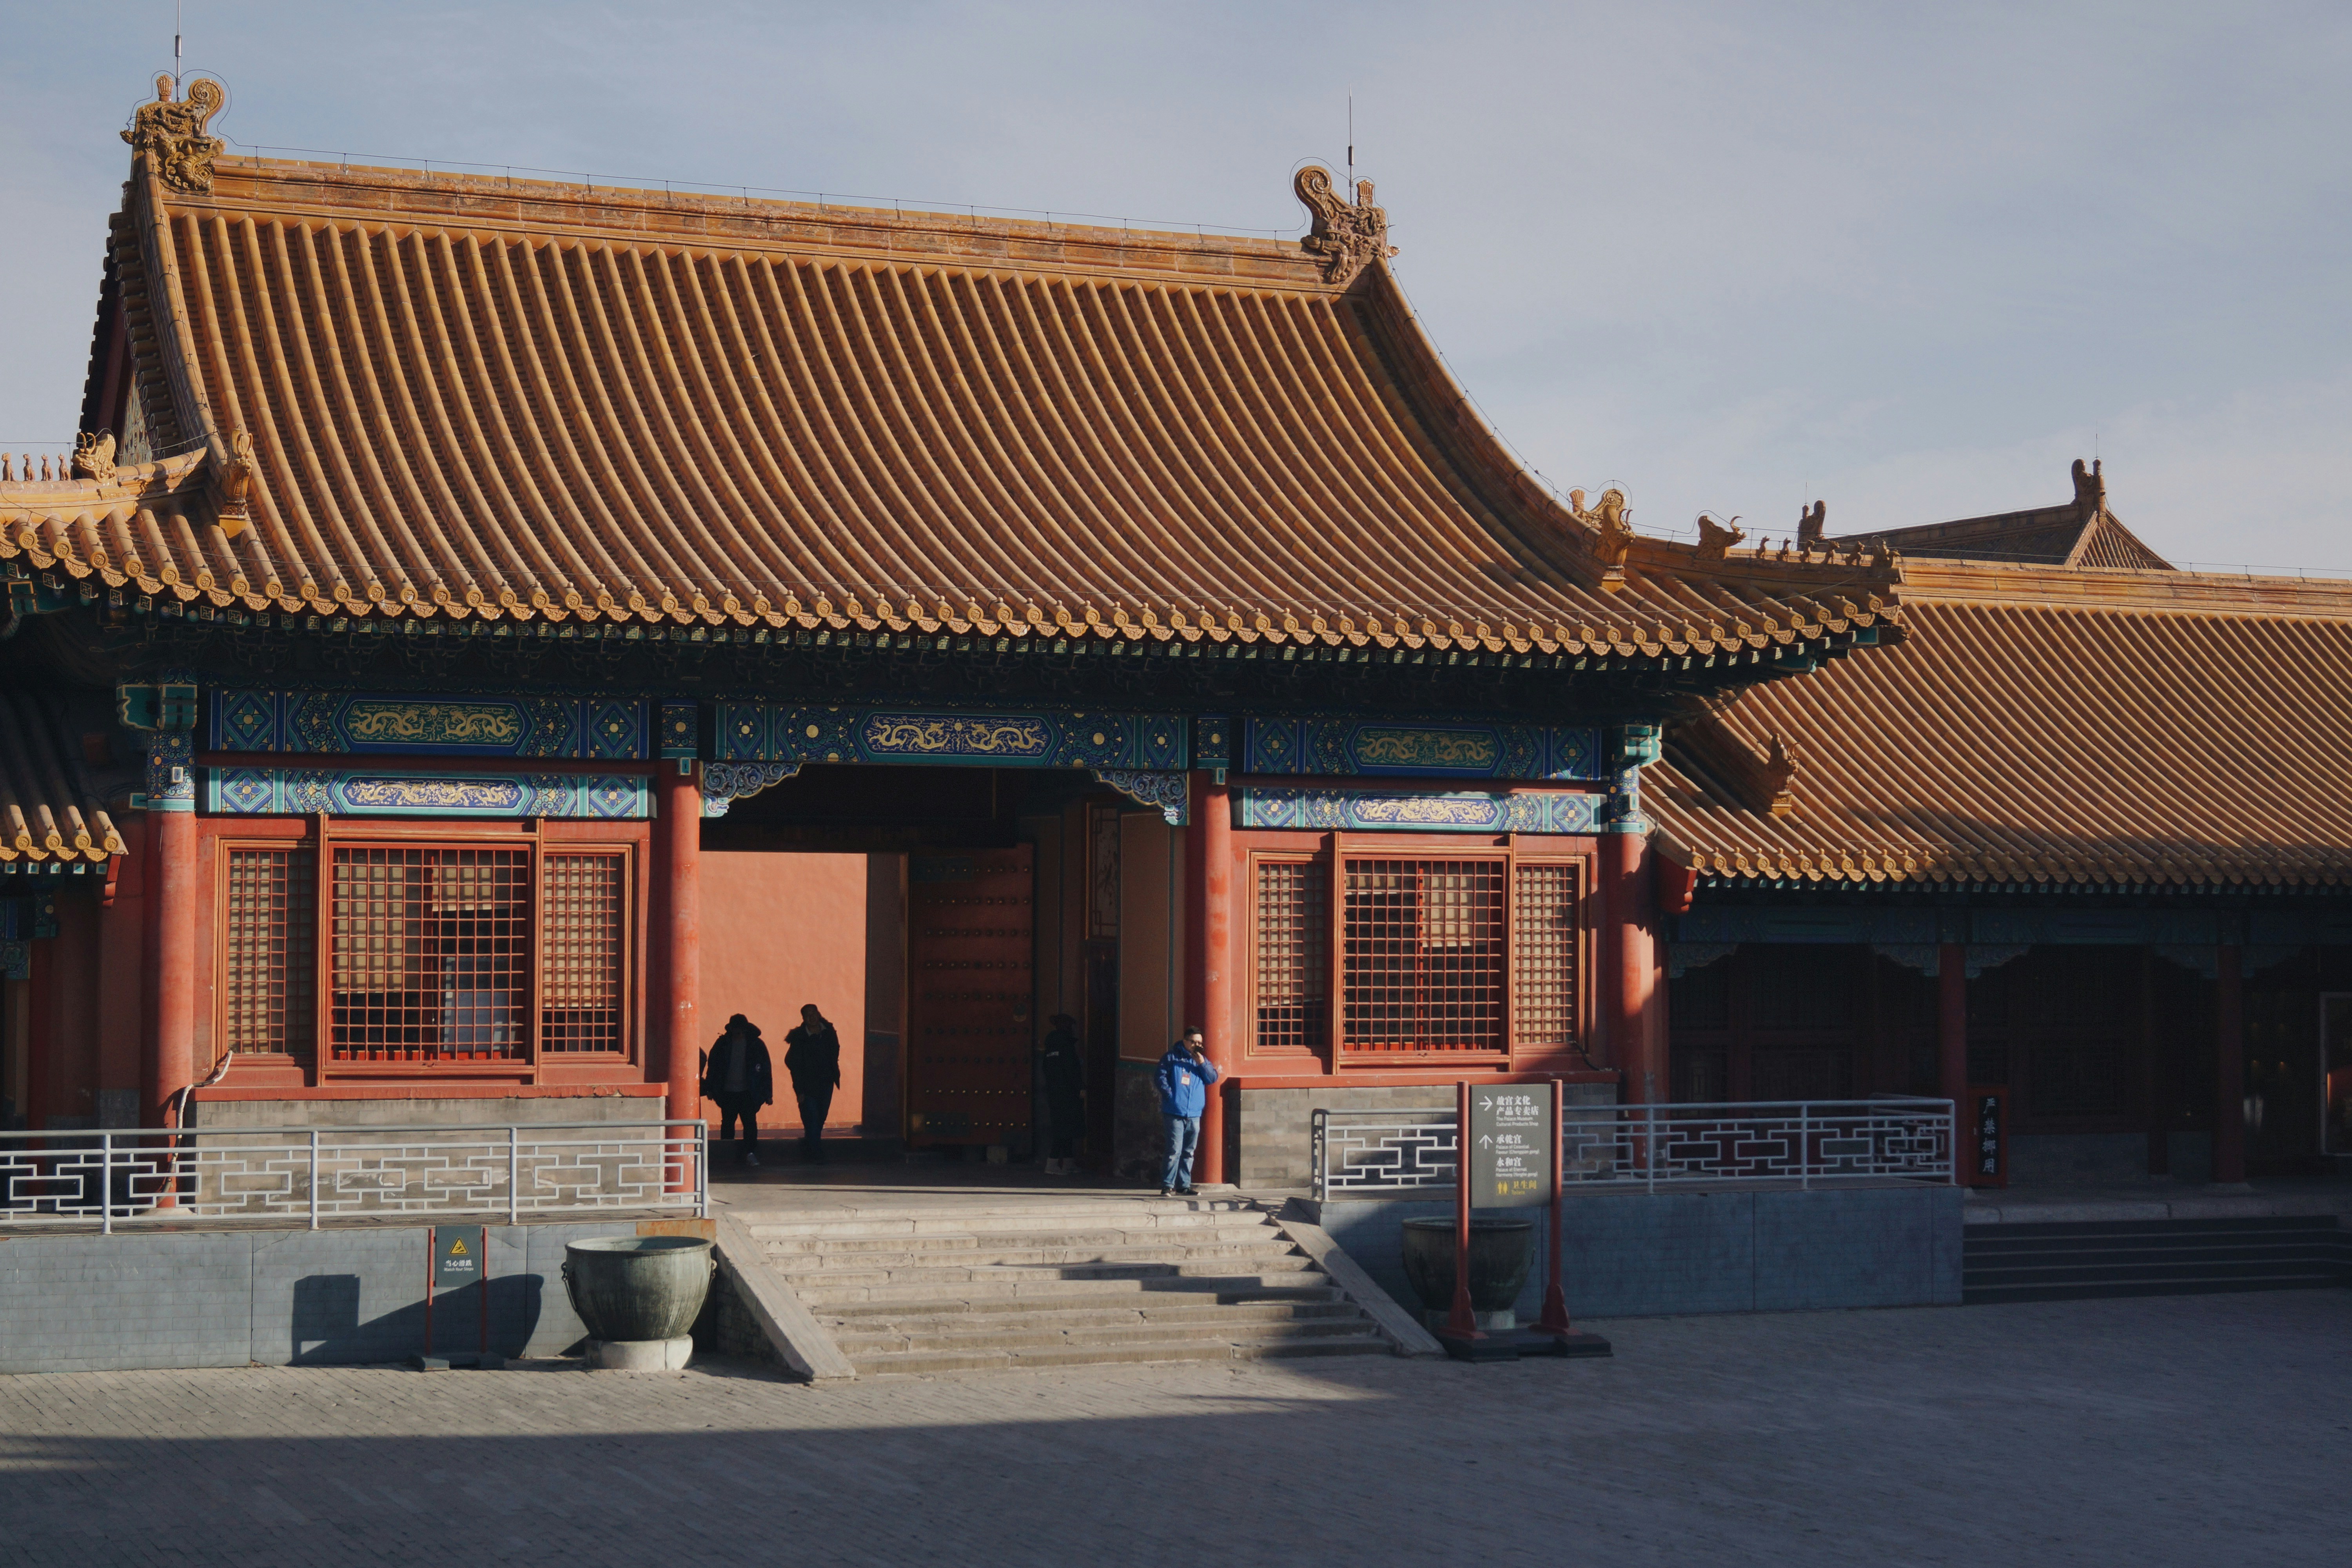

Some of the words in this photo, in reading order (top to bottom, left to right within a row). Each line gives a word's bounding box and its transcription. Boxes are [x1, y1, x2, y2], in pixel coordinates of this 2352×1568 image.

[1496, 1095, 1531, 1105] 故宫文化
[1496, 1105, 1539, 1116] 产品专卖店
[1496, 1157, 1522, 1167] 永和宫
[1514, 1180, 1537, 1190] 卫生间
